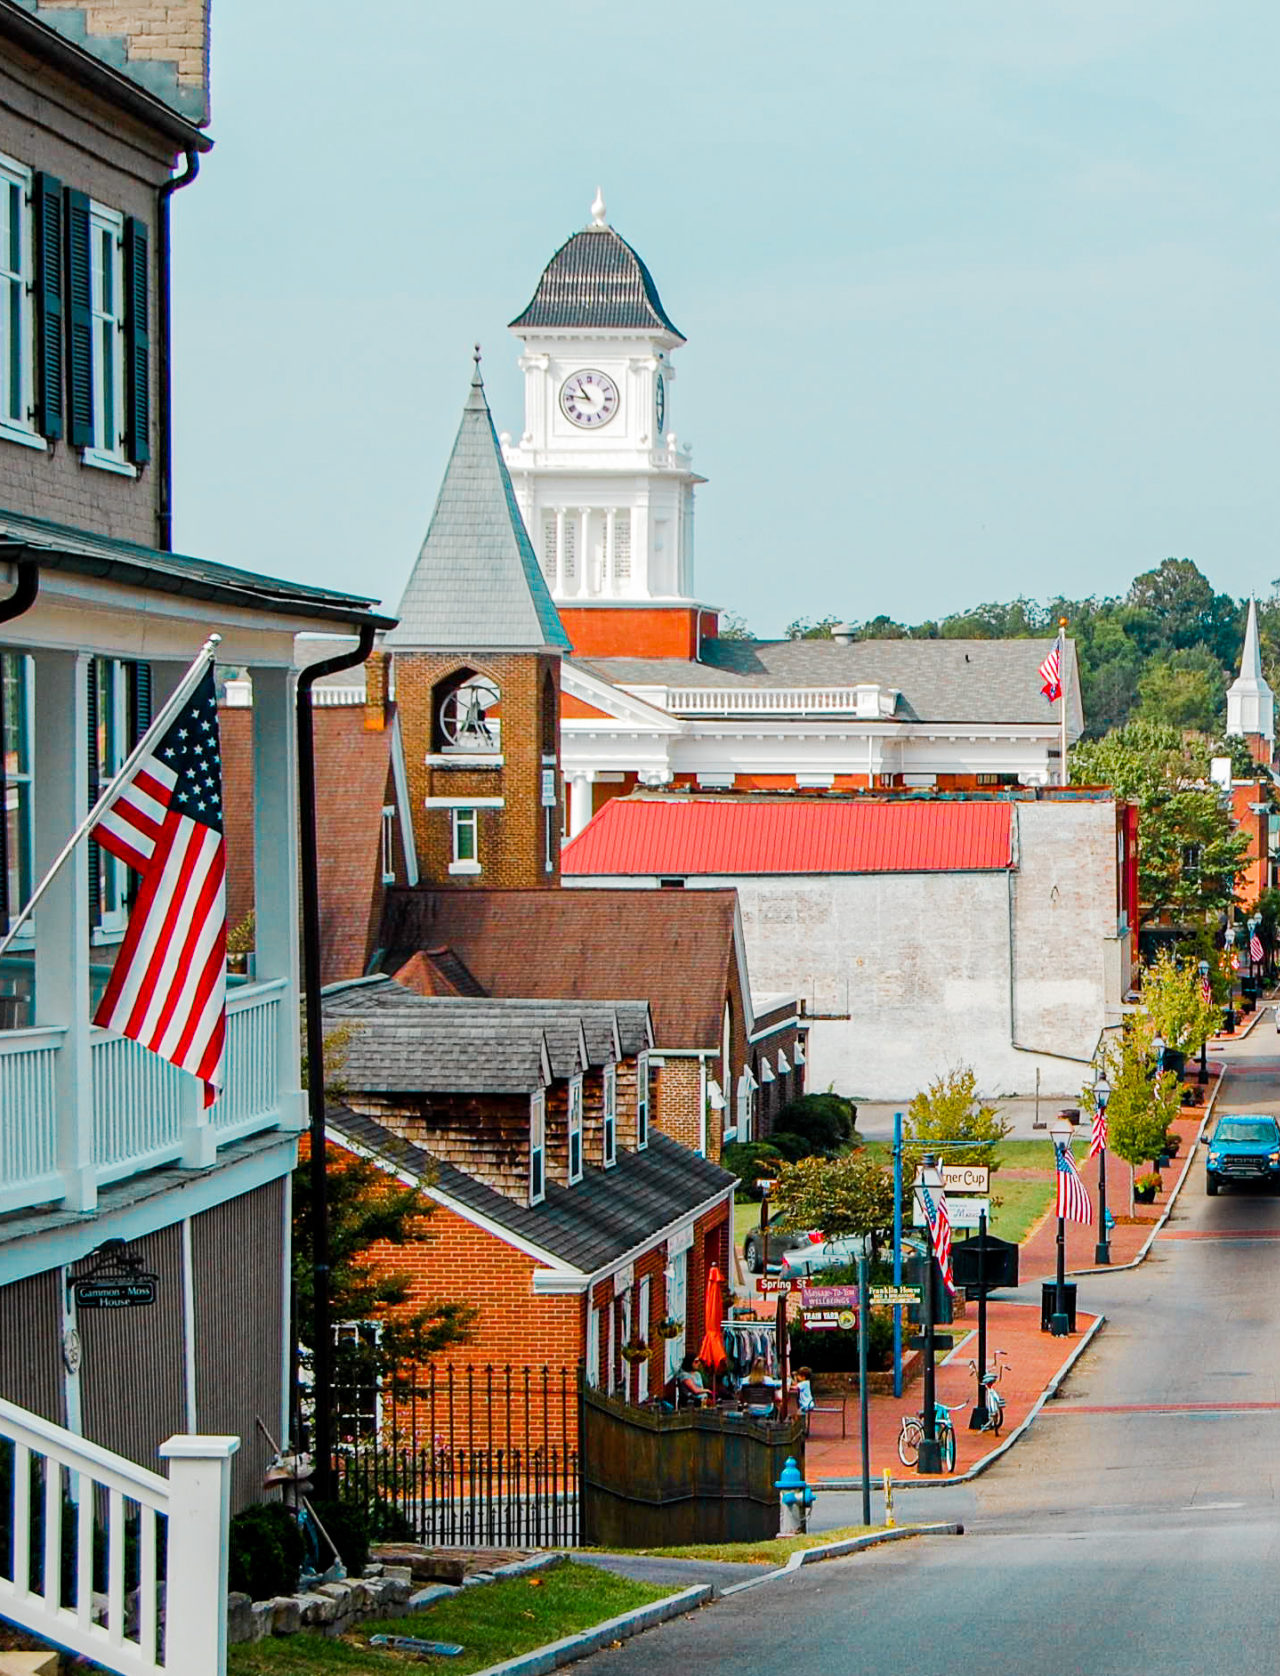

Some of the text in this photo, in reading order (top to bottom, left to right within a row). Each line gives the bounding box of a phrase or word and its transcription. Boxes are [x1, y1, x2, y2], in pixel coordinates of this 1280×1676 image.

[964, 1170, 985, 1188] Cup
[761, 1279, 807, 1291] Spring St
[80, 1288, 120, 1298] Gammon
[127, 1286, 150, 1296] Moss
[99, 1297, 131, 1307] House
